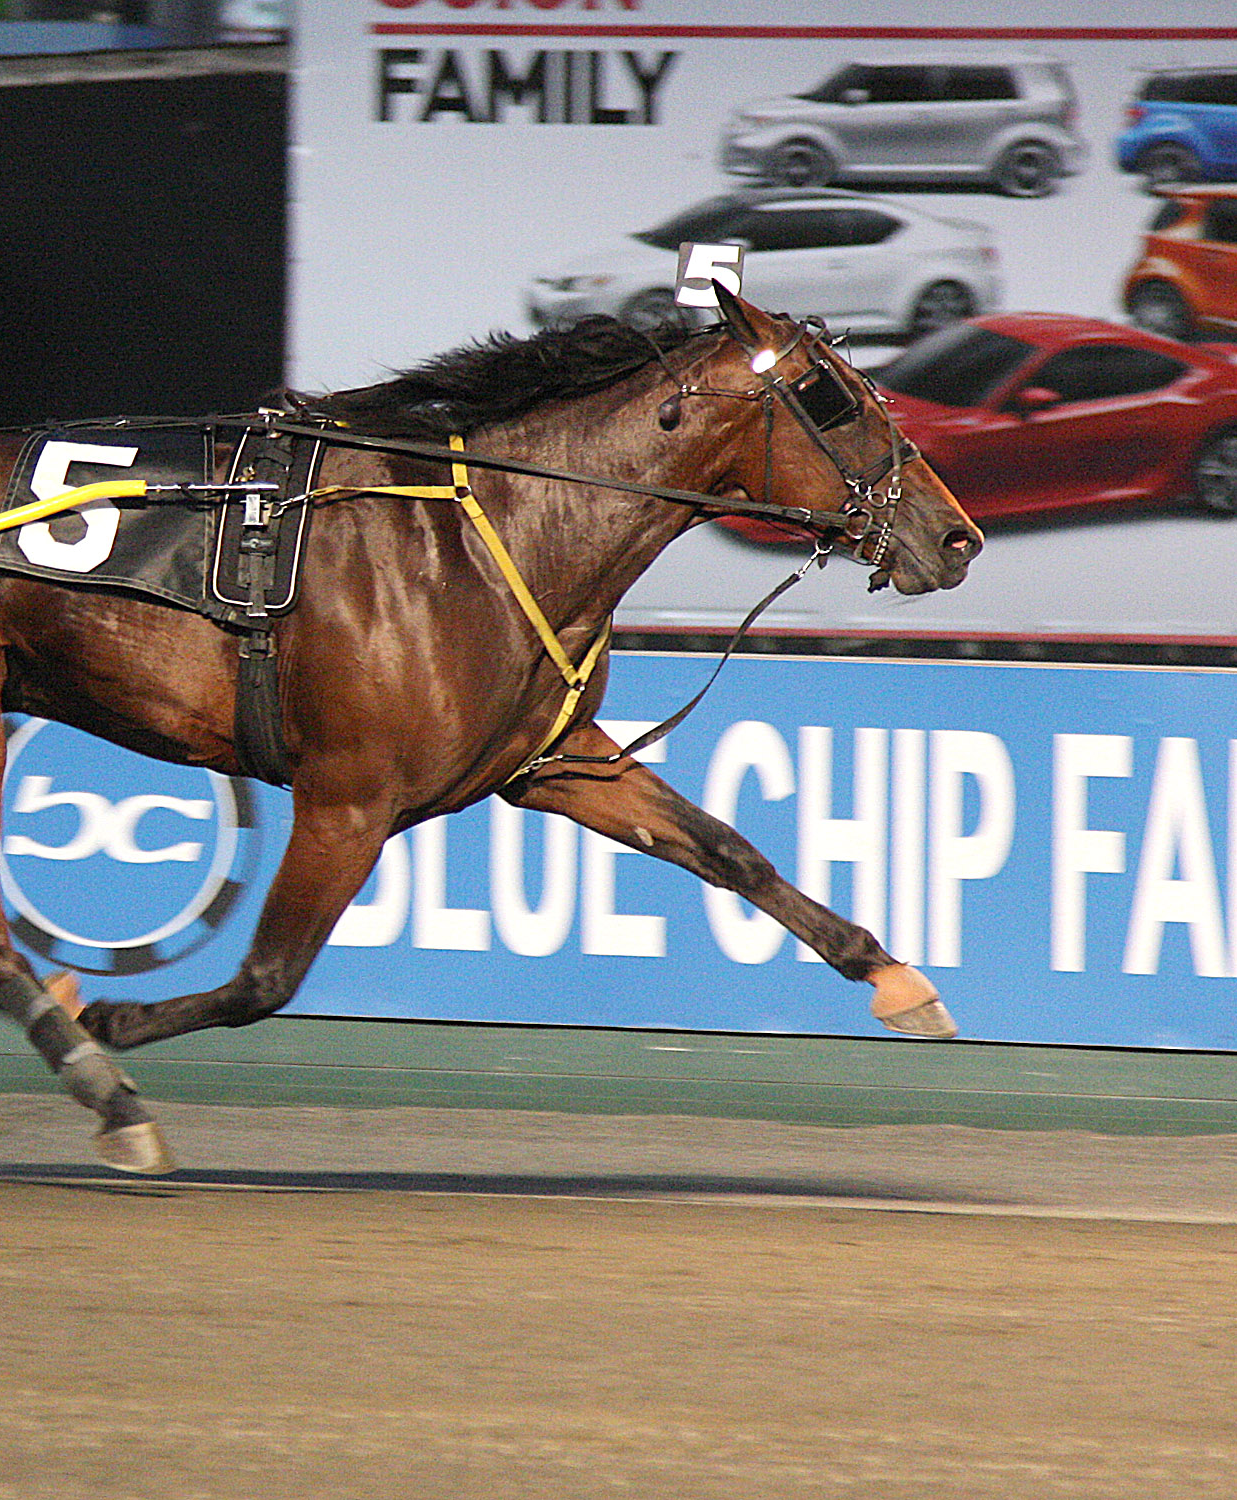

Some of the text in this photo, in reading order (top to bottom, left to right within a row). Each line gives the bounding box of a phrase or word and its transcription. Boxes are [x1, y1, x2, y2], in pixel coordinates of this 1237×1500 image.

[372, 48, 680, 124] FAMILY
[676, 244, 741, 307] 5
[17, 440, 139, 573] 5
[701, 720, 1017, 968] CHIP
[1050, 733, 1237, 978] FA
